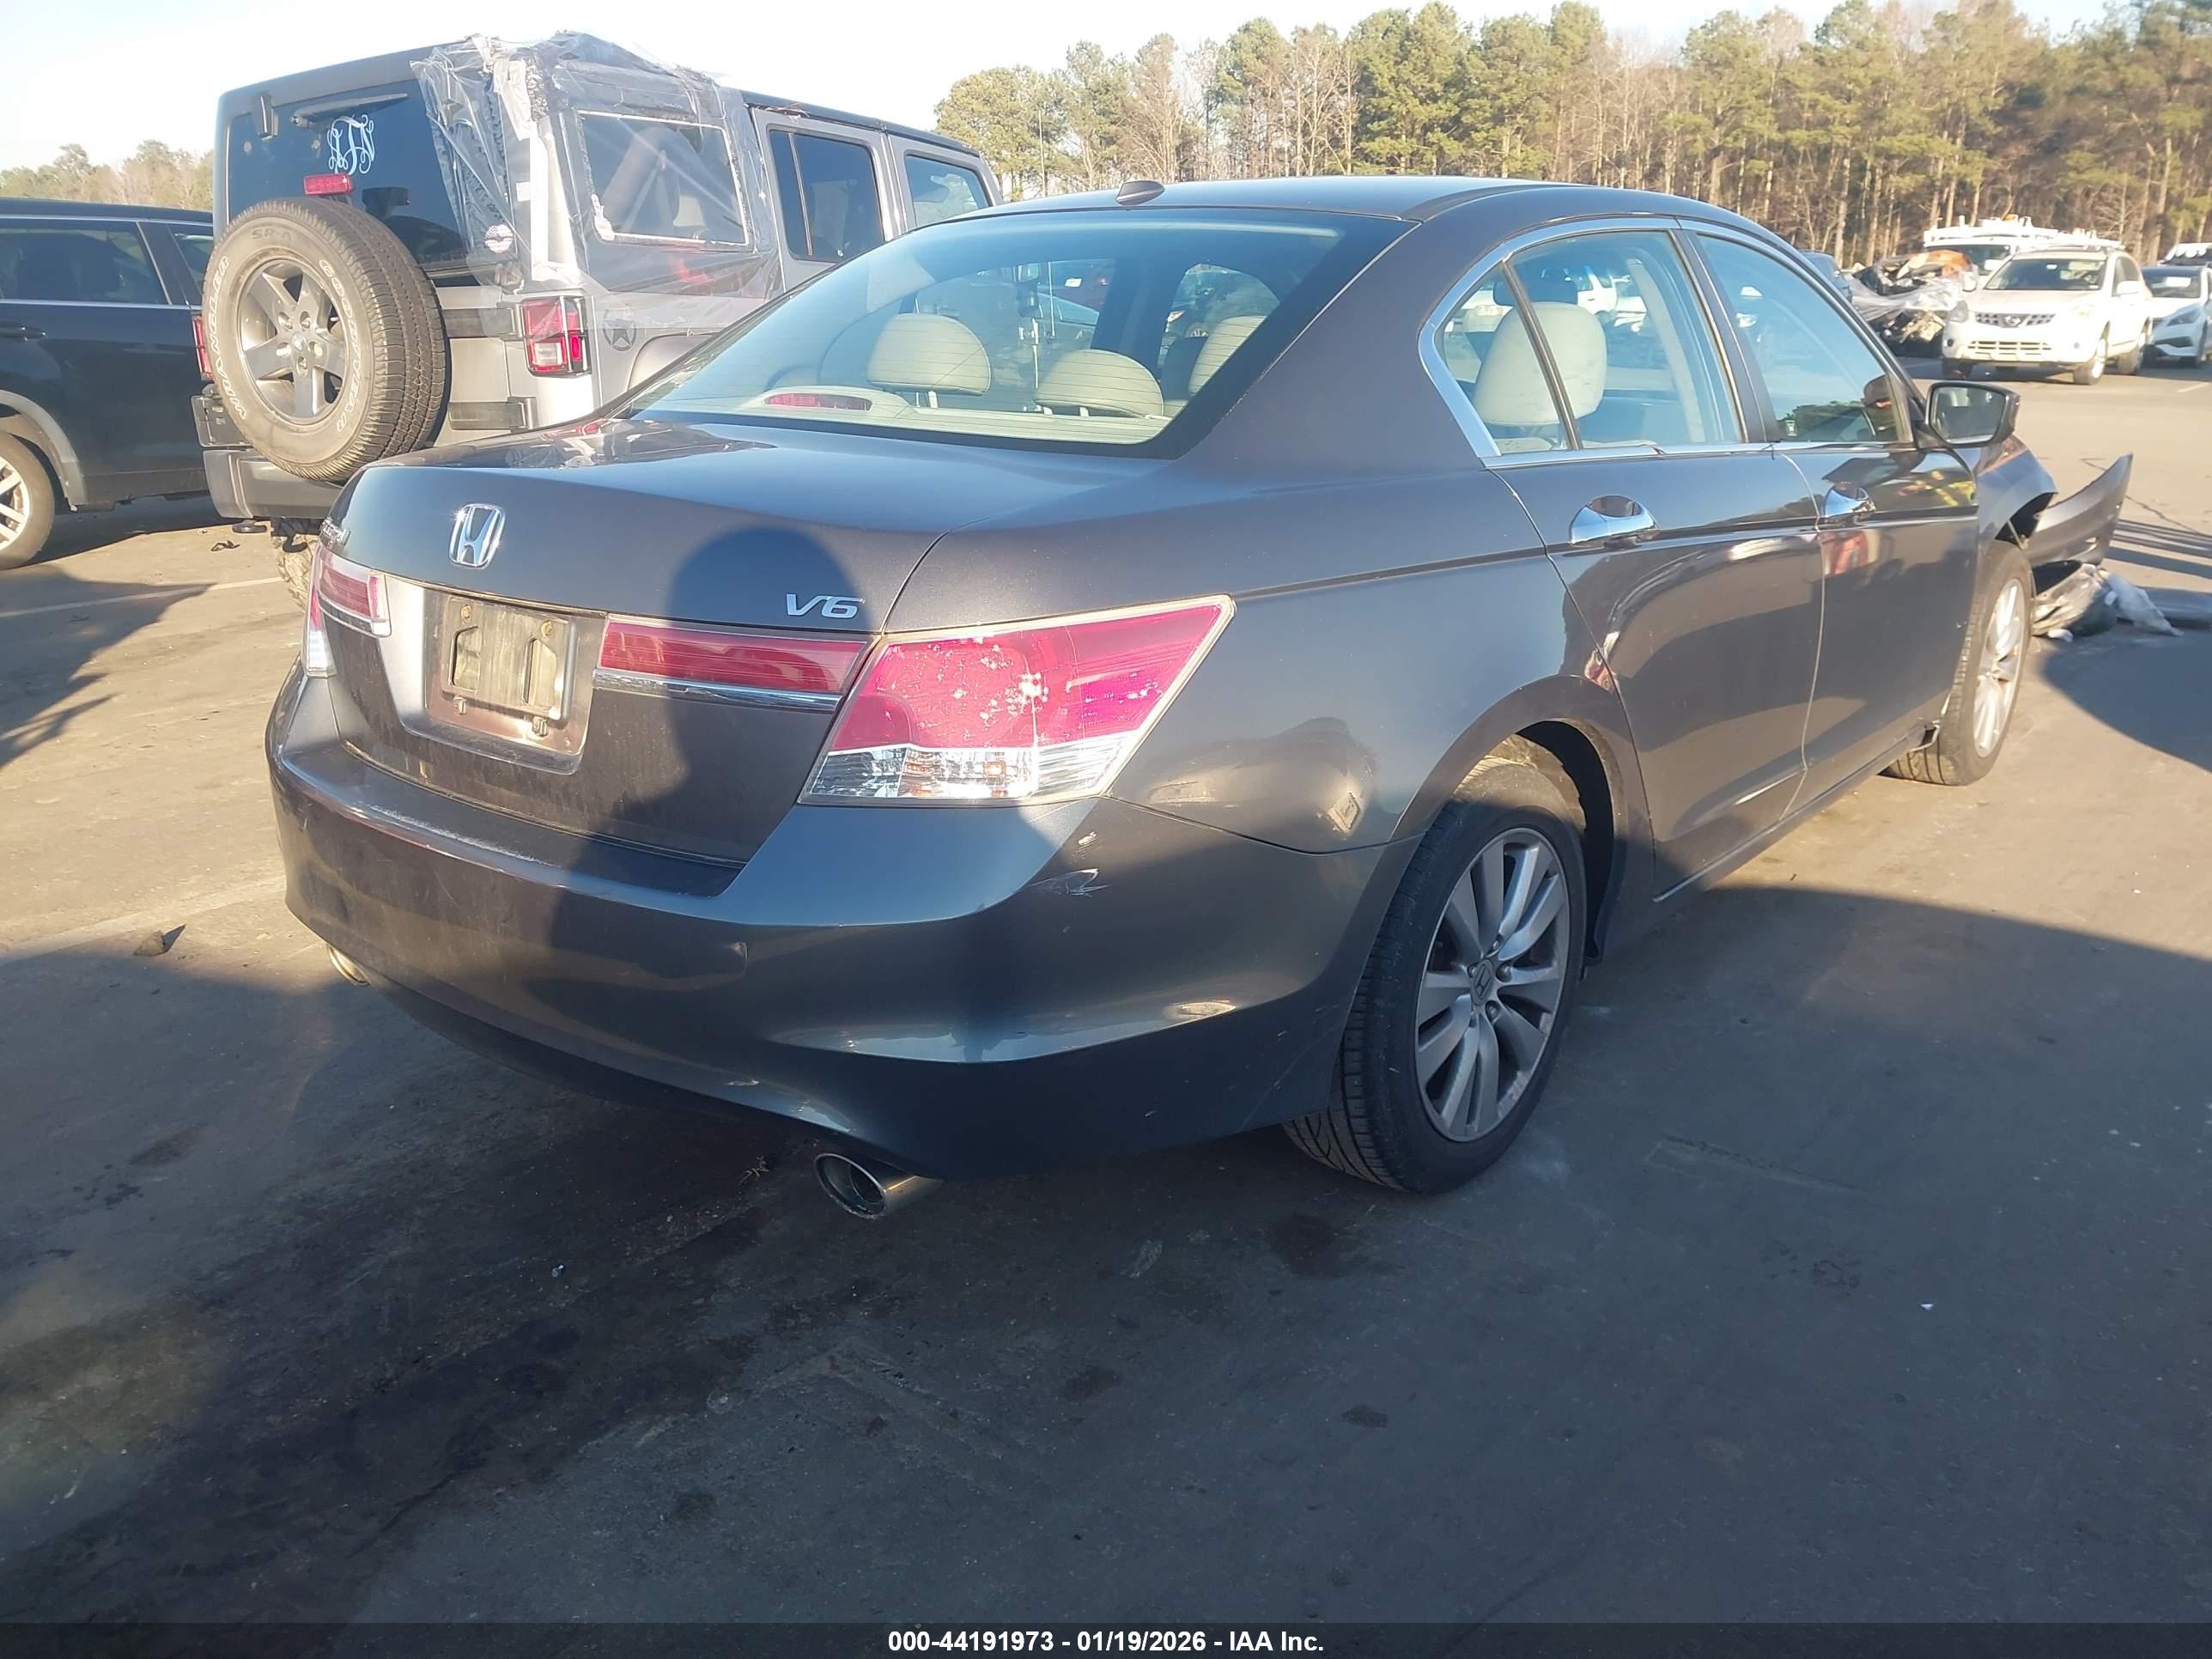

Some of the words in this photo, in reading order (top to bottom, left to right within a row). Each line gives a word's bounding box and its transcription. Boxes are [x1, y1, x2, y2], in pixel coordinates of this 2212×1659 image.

[209, 256, 247, 420] WRANGLER
[319, 259, 362, 433] GOODYEAR
[786, 593, 866, 618] V6
